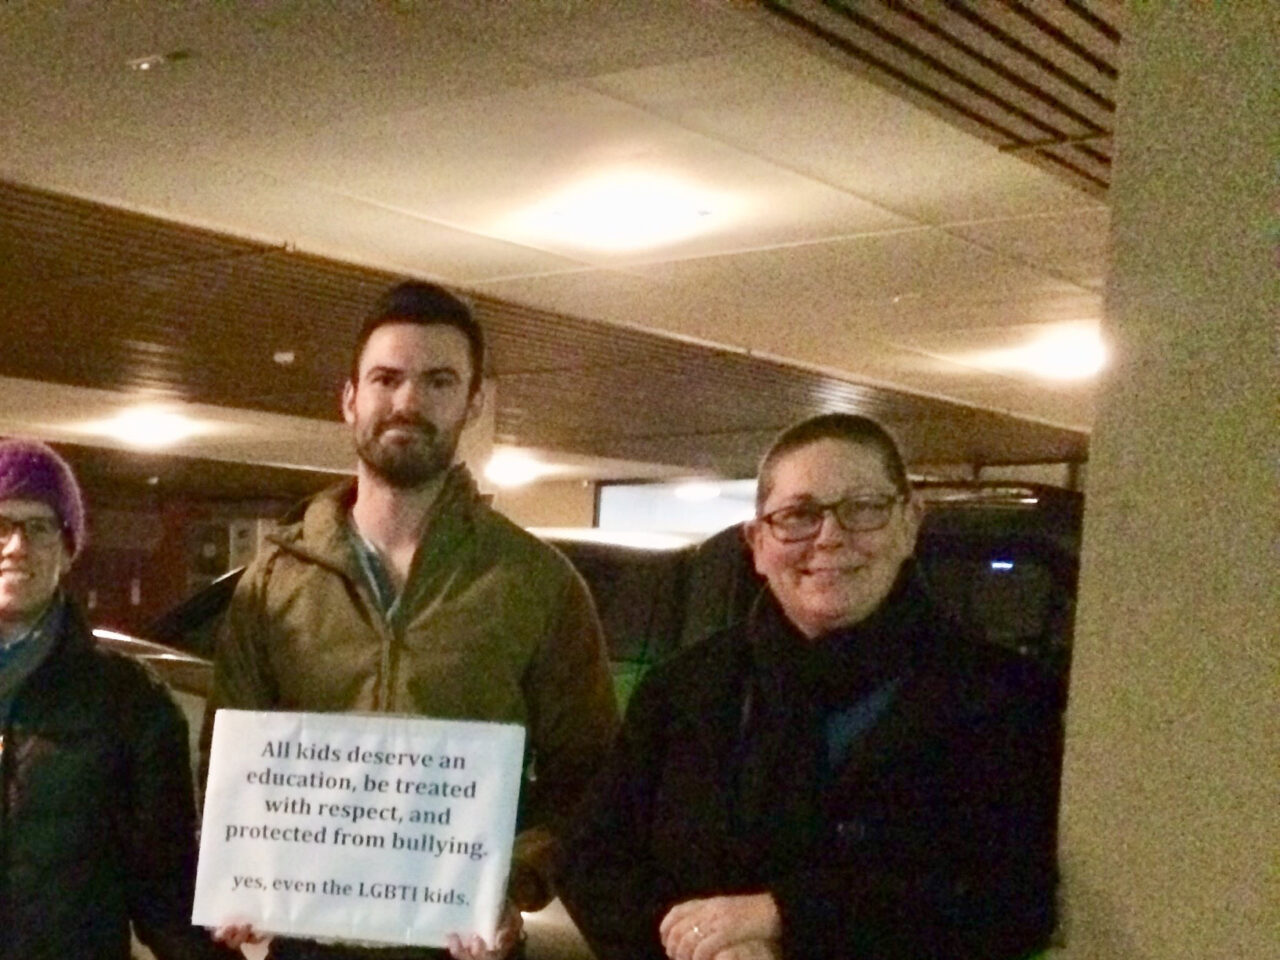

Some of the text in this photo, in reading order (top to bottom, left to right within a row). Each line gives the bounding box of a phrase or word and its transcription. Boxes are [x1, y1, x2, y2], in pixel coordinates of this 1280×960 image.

[262, 742, 465, 770] All kids deserve an
[247, 767, 477, 798] education, be treated
[265, 797, 451, 826] with respect, and
[225, 821, 488, 860] protected from bullying.
[232, 874, 470, 906] yes, even the LGBTI kids.
